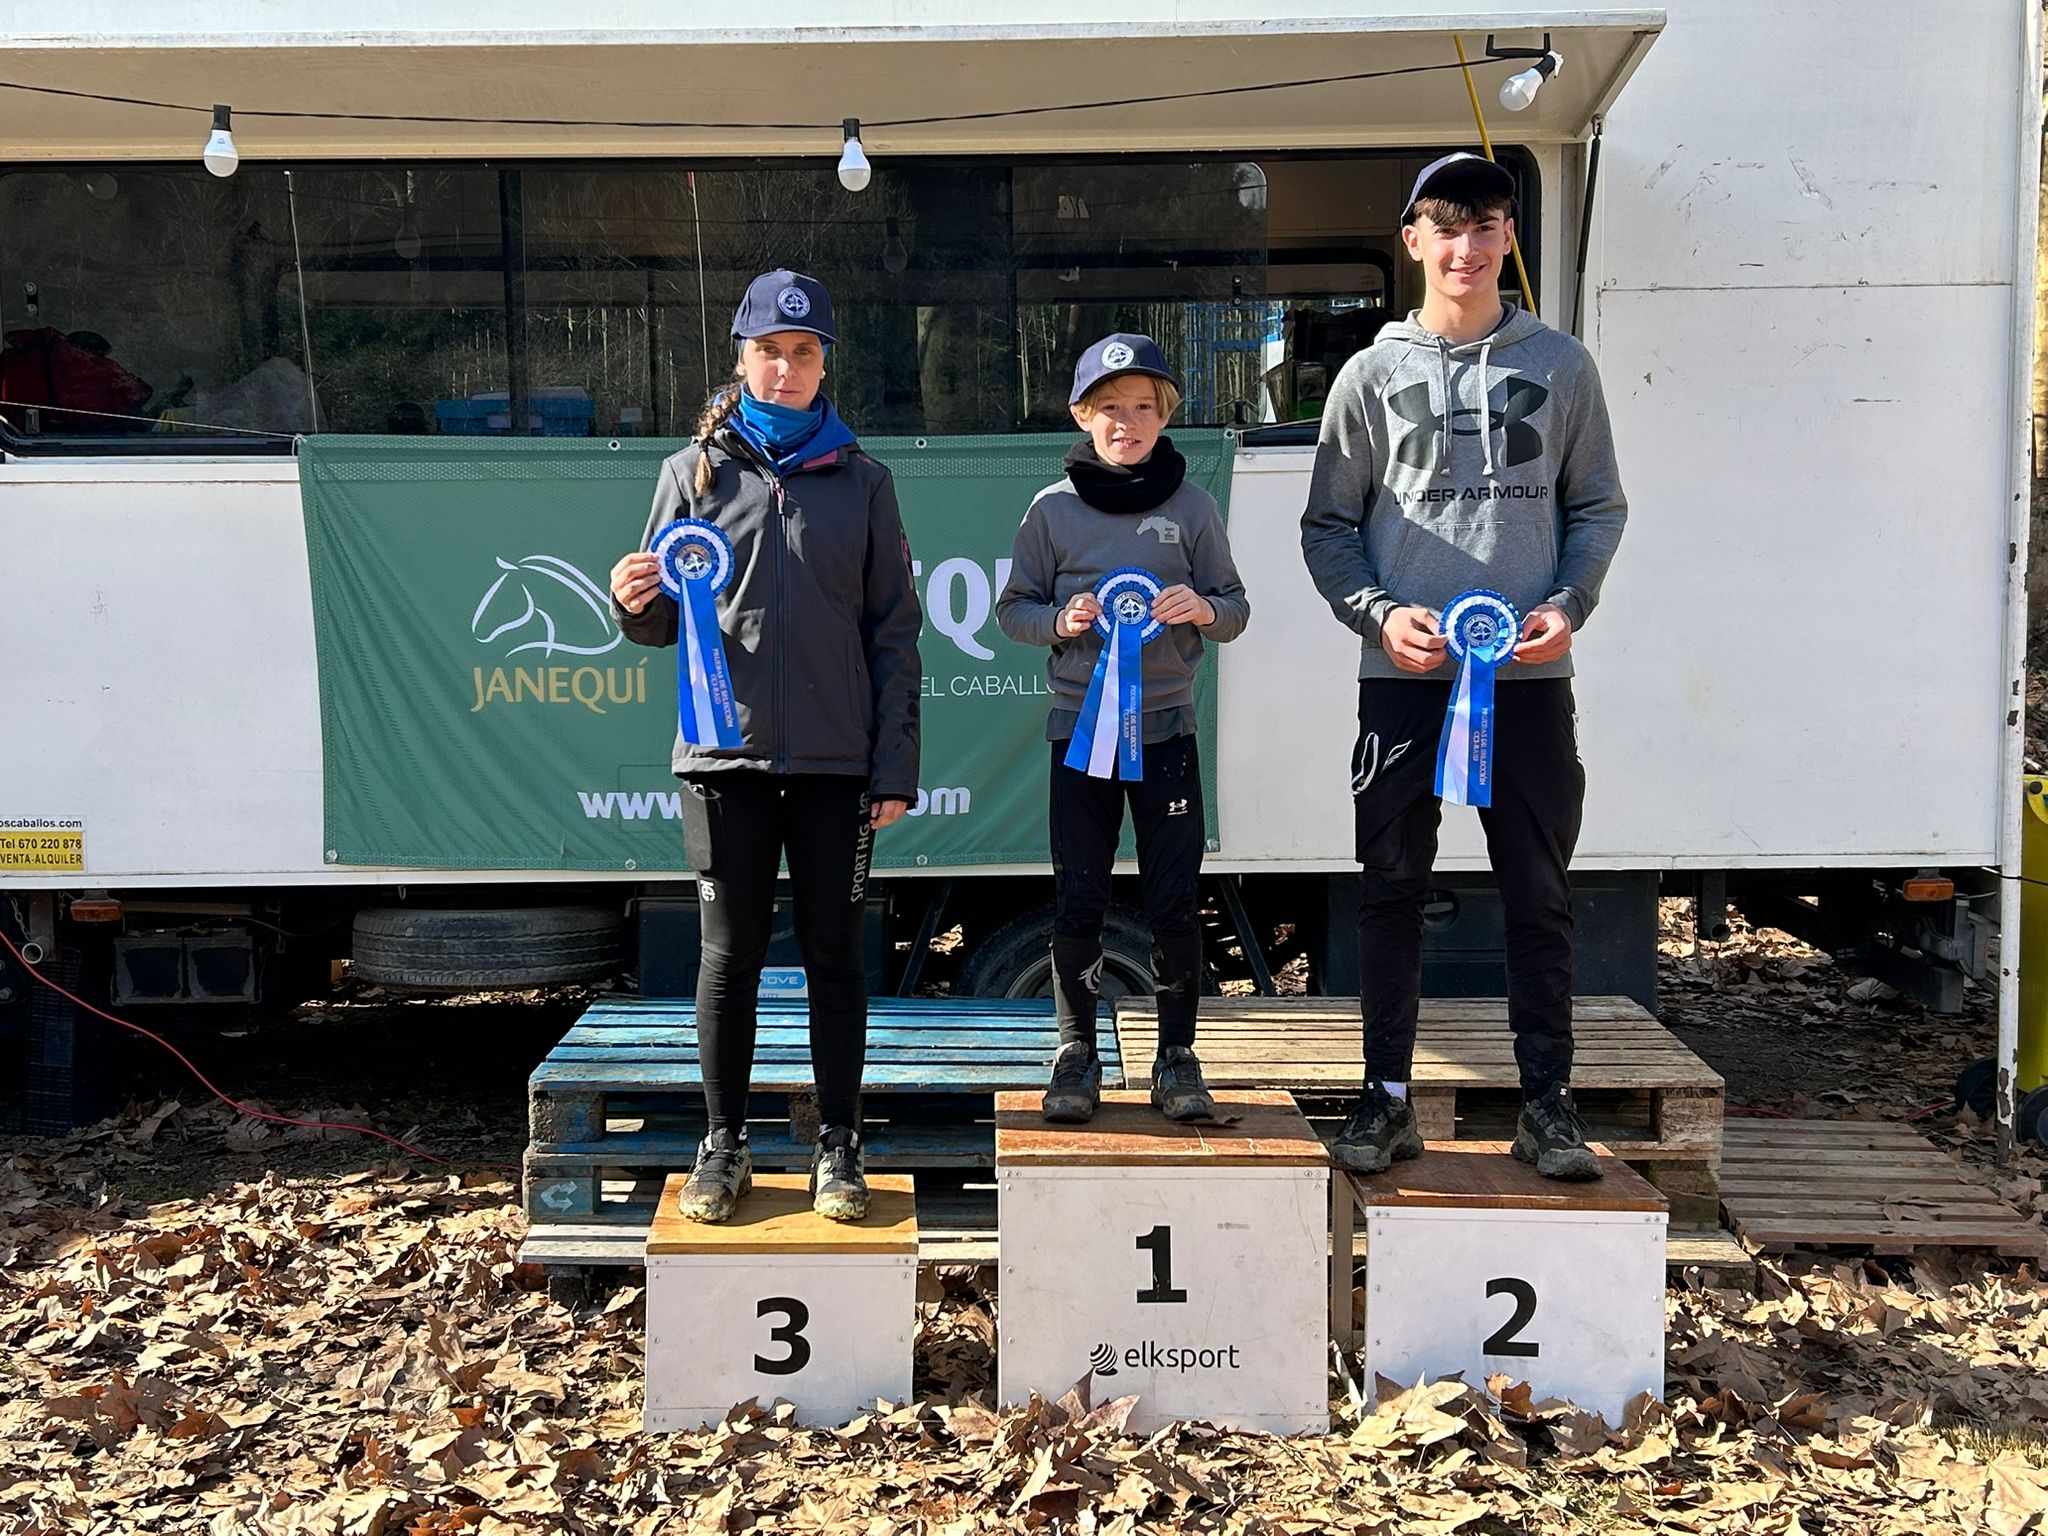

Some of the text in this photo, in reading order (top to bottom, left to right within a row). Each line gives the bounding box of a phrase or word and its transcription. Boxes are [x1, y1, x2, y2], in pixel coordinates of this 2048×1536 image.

[1394, 485, 1549, 506] UNDER ARMOUR
[470, 657, 648, 714] JANEQUÍ
[0, 838, 82, 849] Tel 670 220 878
[0, 853, 82, 865] VENTA-ALQUILER
[1136, 1225, 1188, 1304] 1
[753, 1297, 812, 1375] 3
[1482, 1277, 1541, 1358] 2
[1124, 1340, 1240, 1374] elksport
